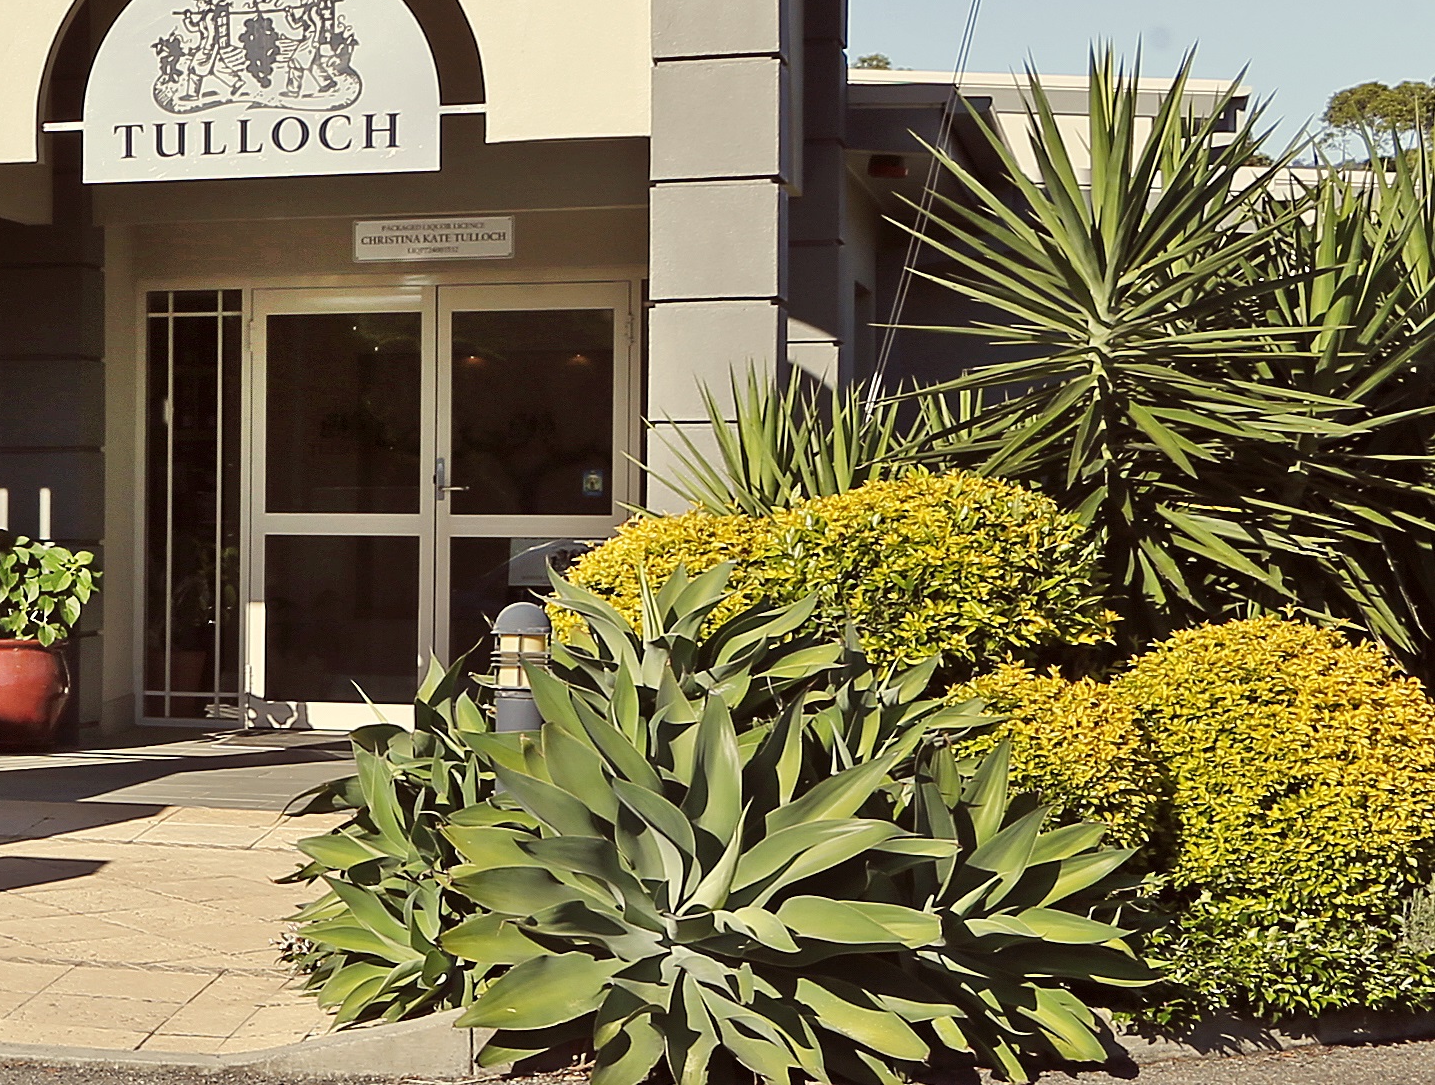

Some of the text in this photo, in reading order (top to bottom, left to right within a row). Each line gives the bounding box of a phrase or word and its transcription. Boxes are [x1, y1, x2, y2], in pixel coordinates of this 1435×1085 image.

[113, 112, 401, 159] TULLOCH
[381, 221, 485, 232] PACKAGED LIQUOR LICENCE
[361, 231, 507, 246] CHRISTINA KATE TULLOCH
